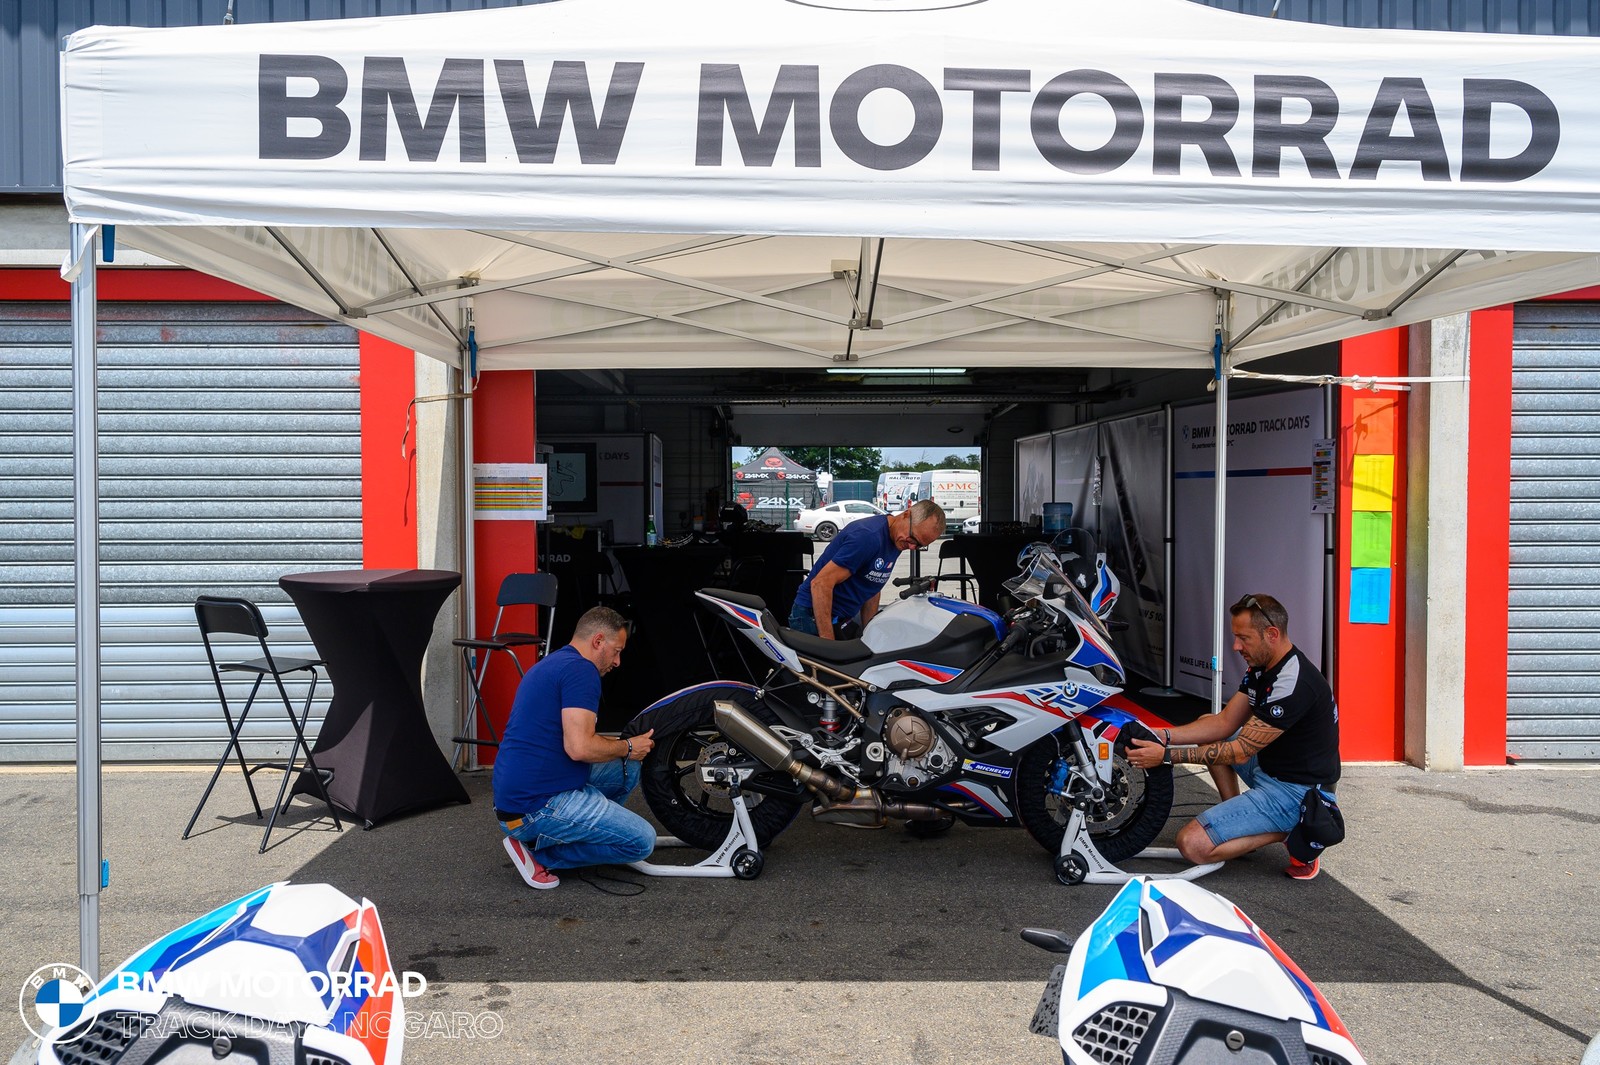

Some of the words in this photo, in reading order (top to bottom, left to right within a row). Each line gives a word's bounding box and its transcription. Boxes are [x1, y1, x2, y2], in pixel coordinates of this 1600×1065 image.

[258, 53, 645, 165] BMW
[695, 63, 1561, 183] MOTORRAD
[1191, 426, 1211, 439] BMW
[1212, 421, 1257, 437] MTORRAD
[1259, 418, 1287, 433] TRACK
[1287, 414, 1310, 430] DAYS
[604, 451, 631, 461] DAYS
[937, 482, 978, 490] APMC
[758, 496, 804, 505] 24MX
[1179, 655, 1194, 667] MAKE
[1080, 684, 1111, 697] S1000
[975, 764, 1011, 775] MICHELIN
[724, 831, 741, 852] Motorrad
[1079, 836, 1090, 849] BMW
[1087, 848, 1105, 870] Motorrad
